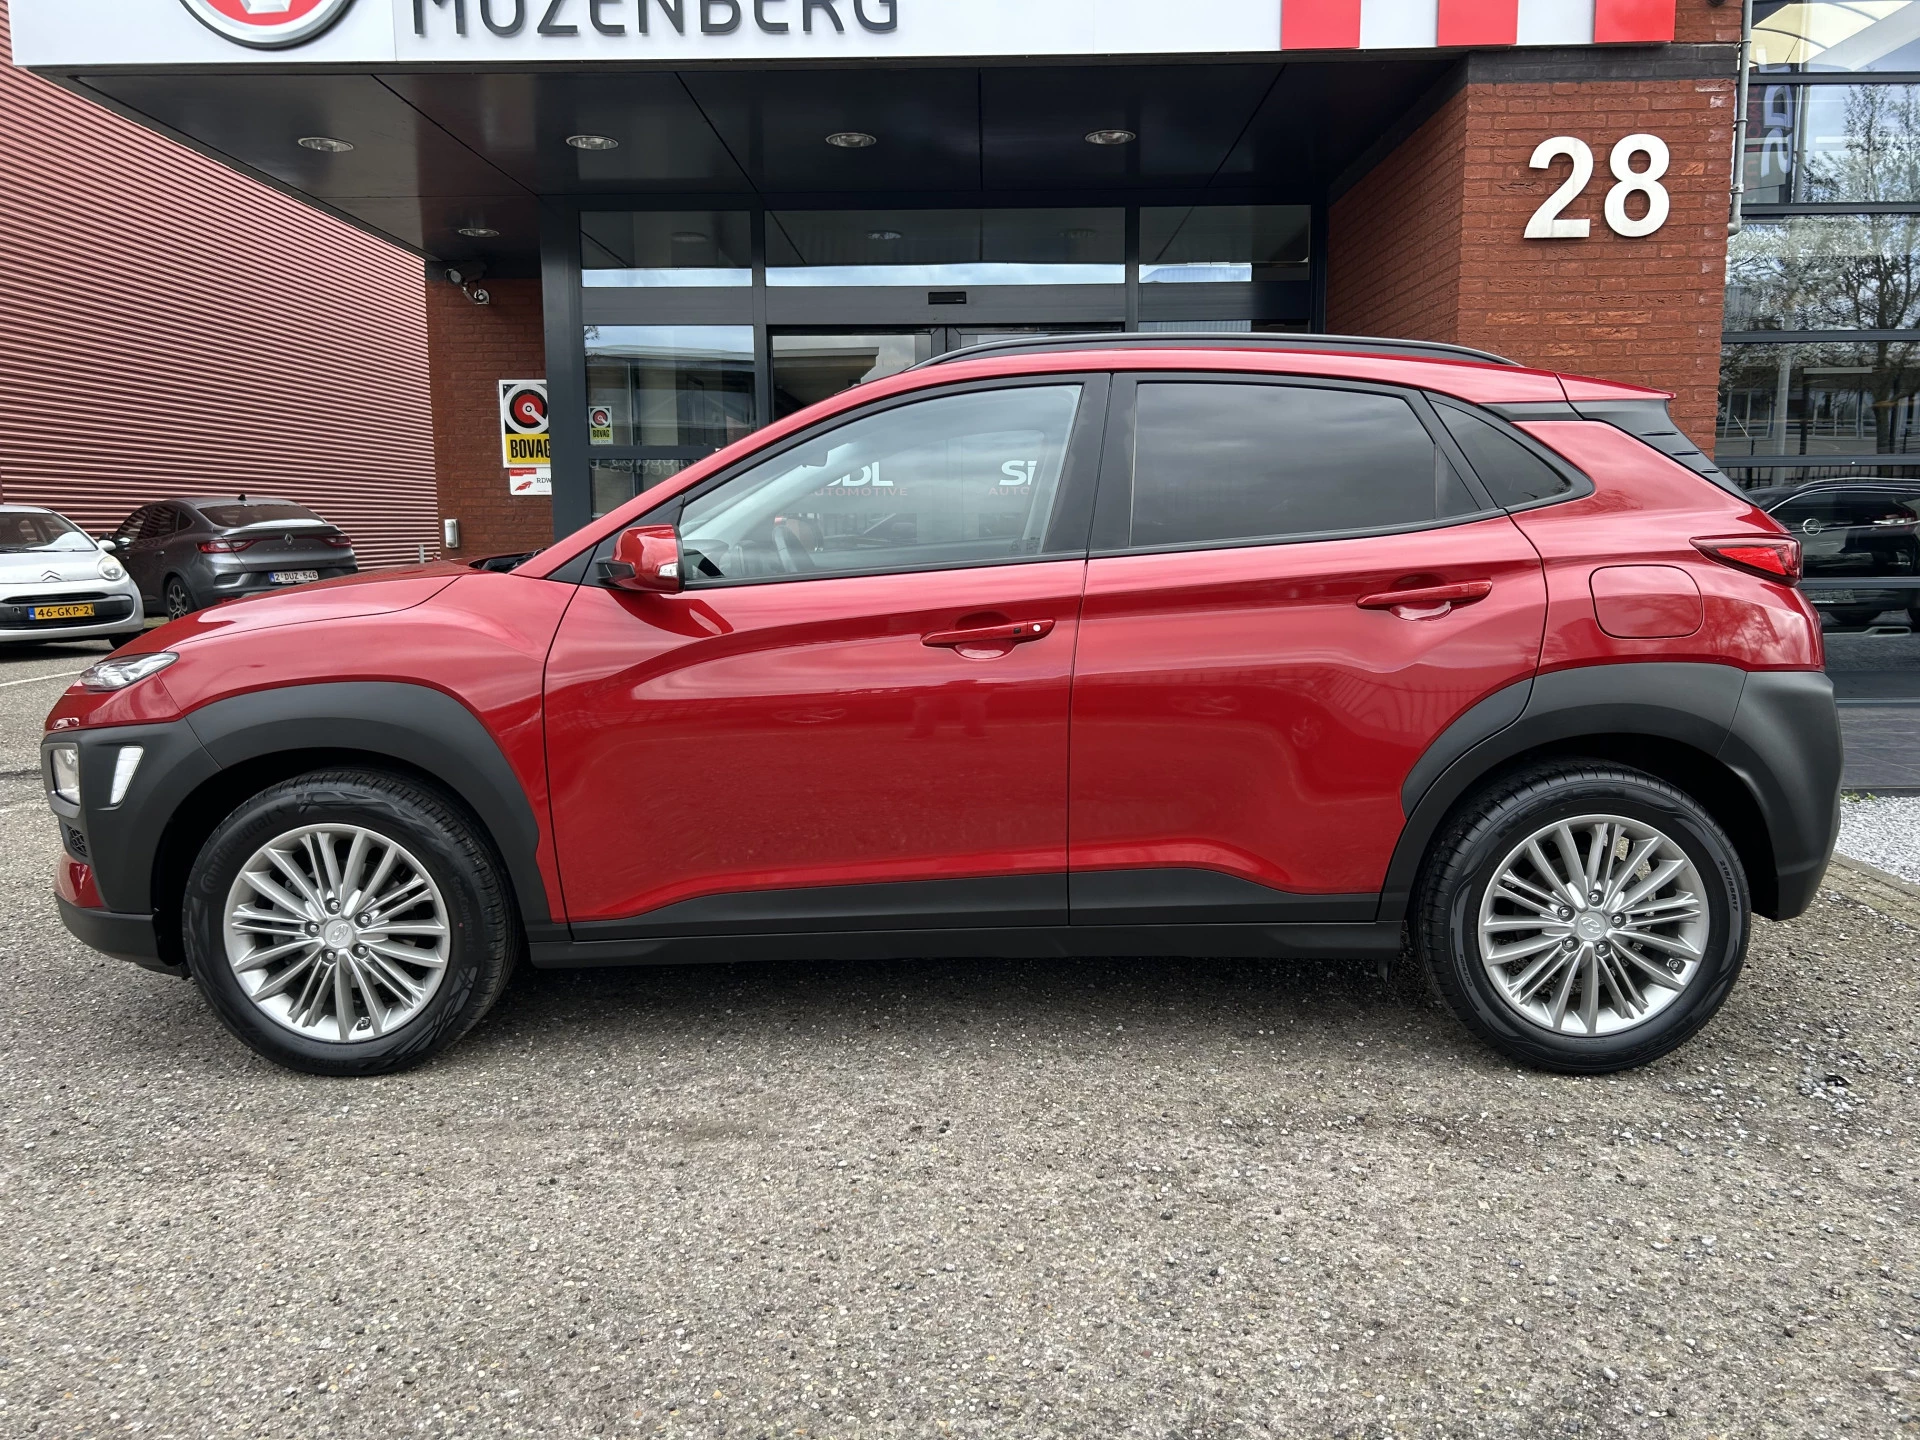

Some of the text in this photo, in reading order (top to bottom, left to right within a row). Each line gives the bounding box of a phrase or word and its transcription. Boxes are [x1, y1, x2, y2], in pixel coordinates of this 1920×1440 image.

[1523, 133, 1670, 238] 28
[592, 429, 610, 438] BOVAG
[810, 487, 908, 496] UTOMOTIVE
